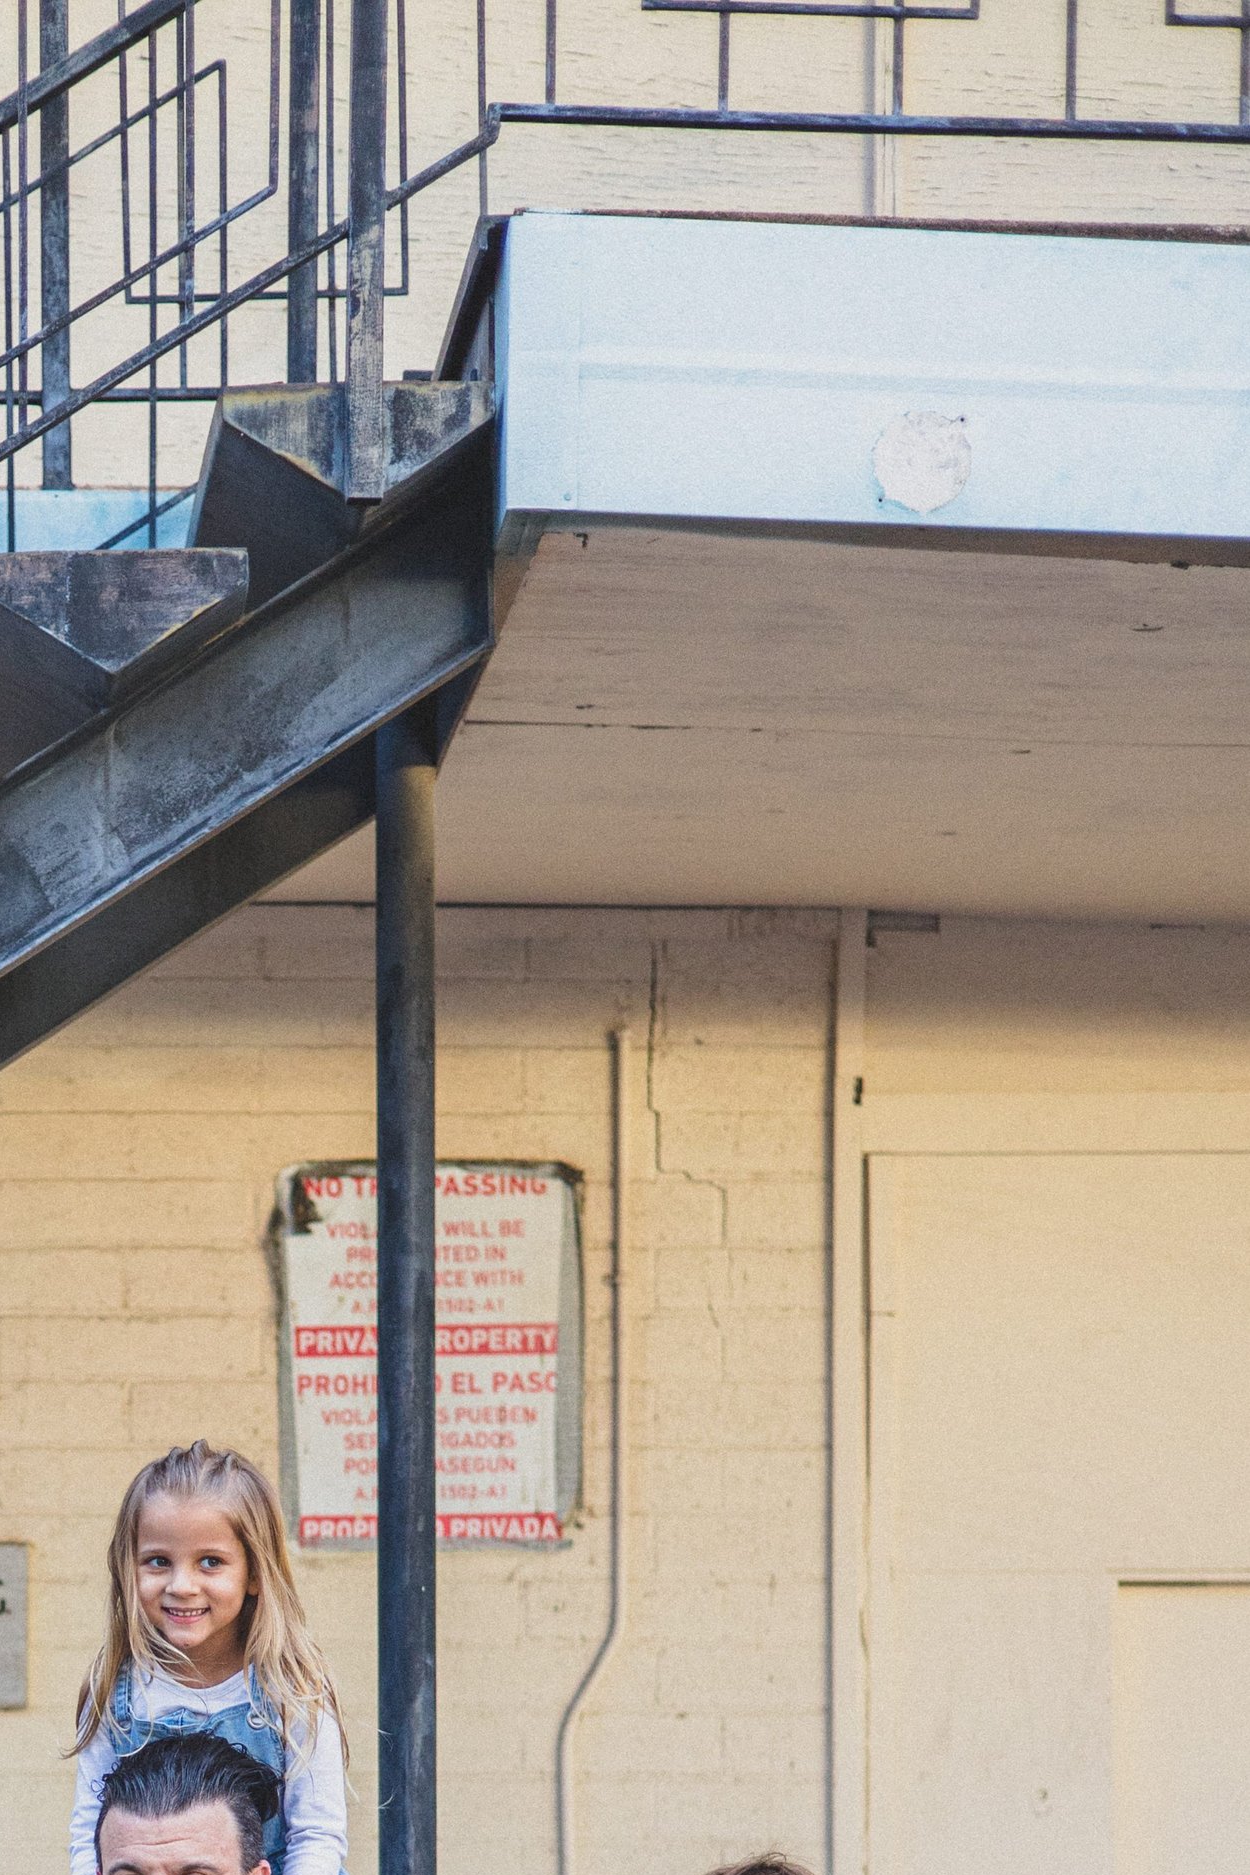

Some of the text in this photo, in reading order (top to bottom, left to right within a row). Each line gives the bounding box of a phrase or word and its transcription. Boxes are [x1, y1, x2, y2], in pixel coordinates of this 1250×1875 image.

[303, 1174, 547, 1198] NO TASSING
[498, 1218, 525, 1238] BE
[300, 1327, 557, 1354] PRIVA ROPERTY
[297, 1373, 442, 1396] PROHI
[452, 1372, 482, 1395] EL
[322, 1406, 450, 1425] VIOLAS
[302, 1518, 558, 1539] PROPI PRIVADA
